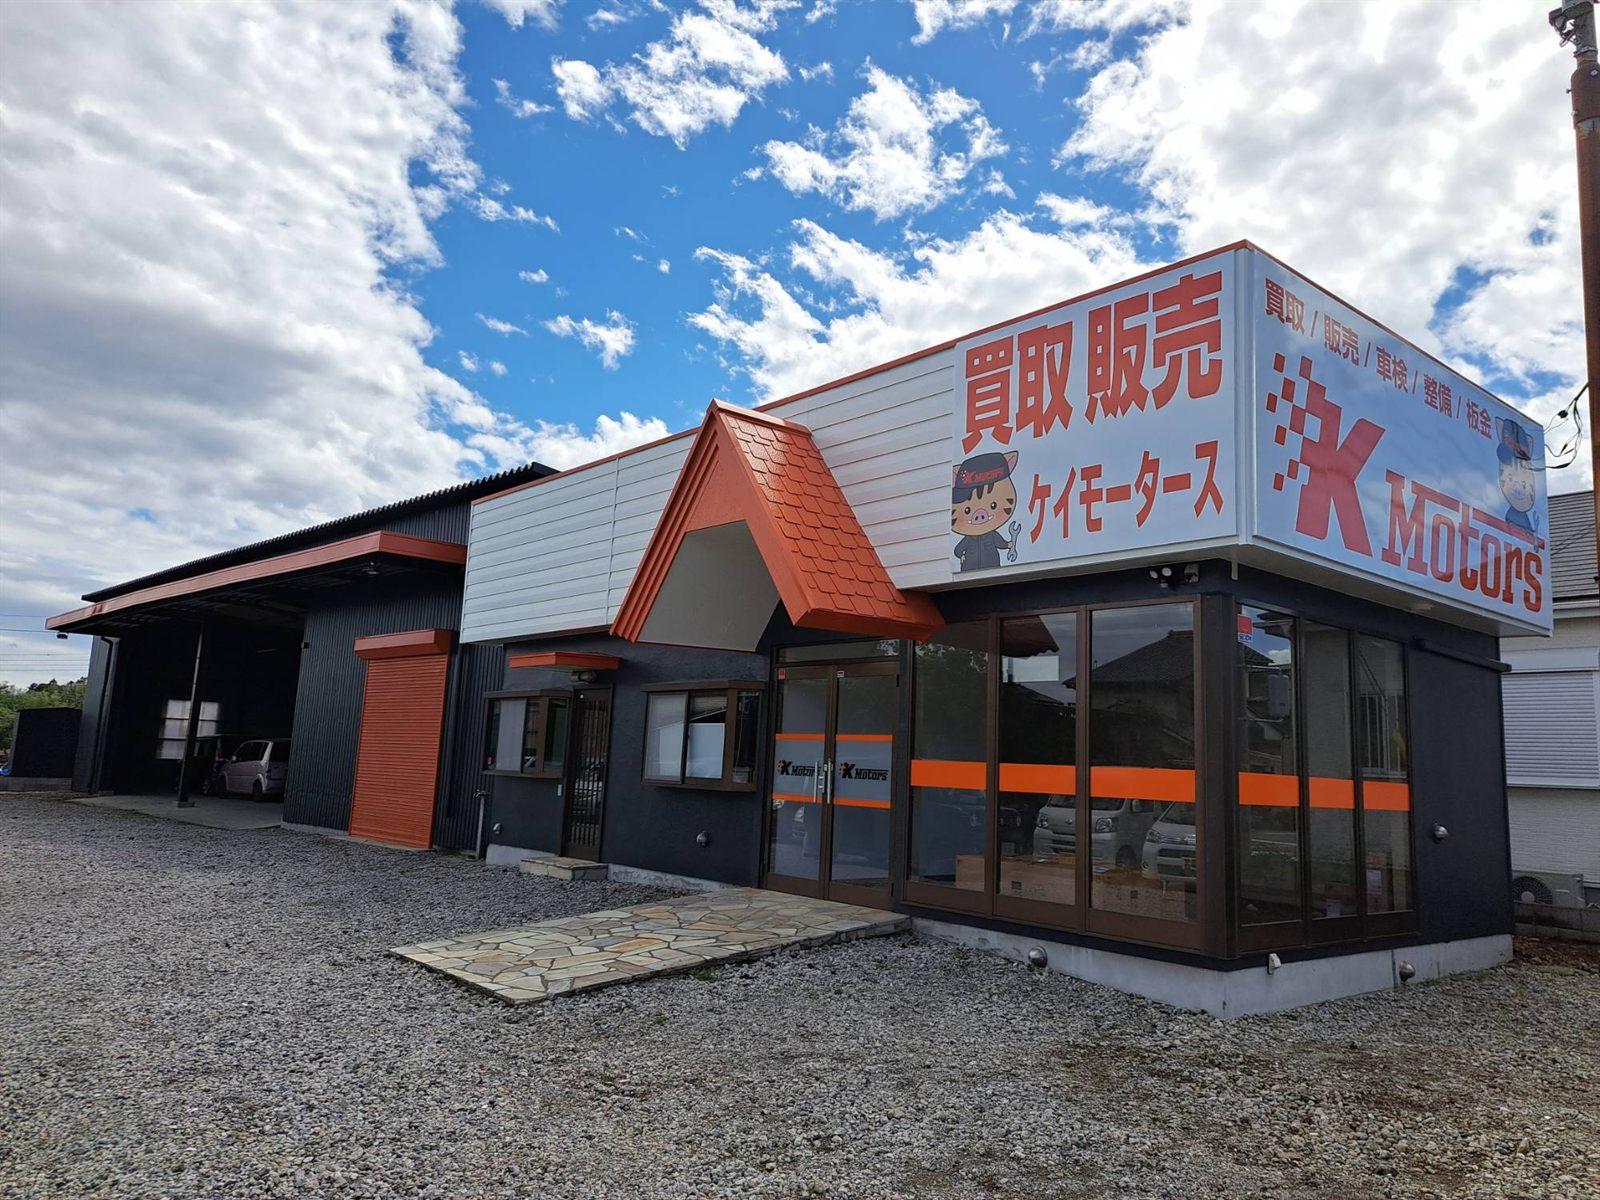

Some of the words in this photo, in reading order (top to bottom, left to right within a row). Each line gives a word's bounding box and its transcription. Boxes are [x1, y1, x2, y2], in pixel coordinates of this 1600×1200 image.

[1028, 440, 1223, 543] ケイモータース
[1286, 384, 1386, 557] K
[1381, 469, 1546, 613] Motors
[841, 762, 855, 779] K
[855, 768, 888, 780] Motors
